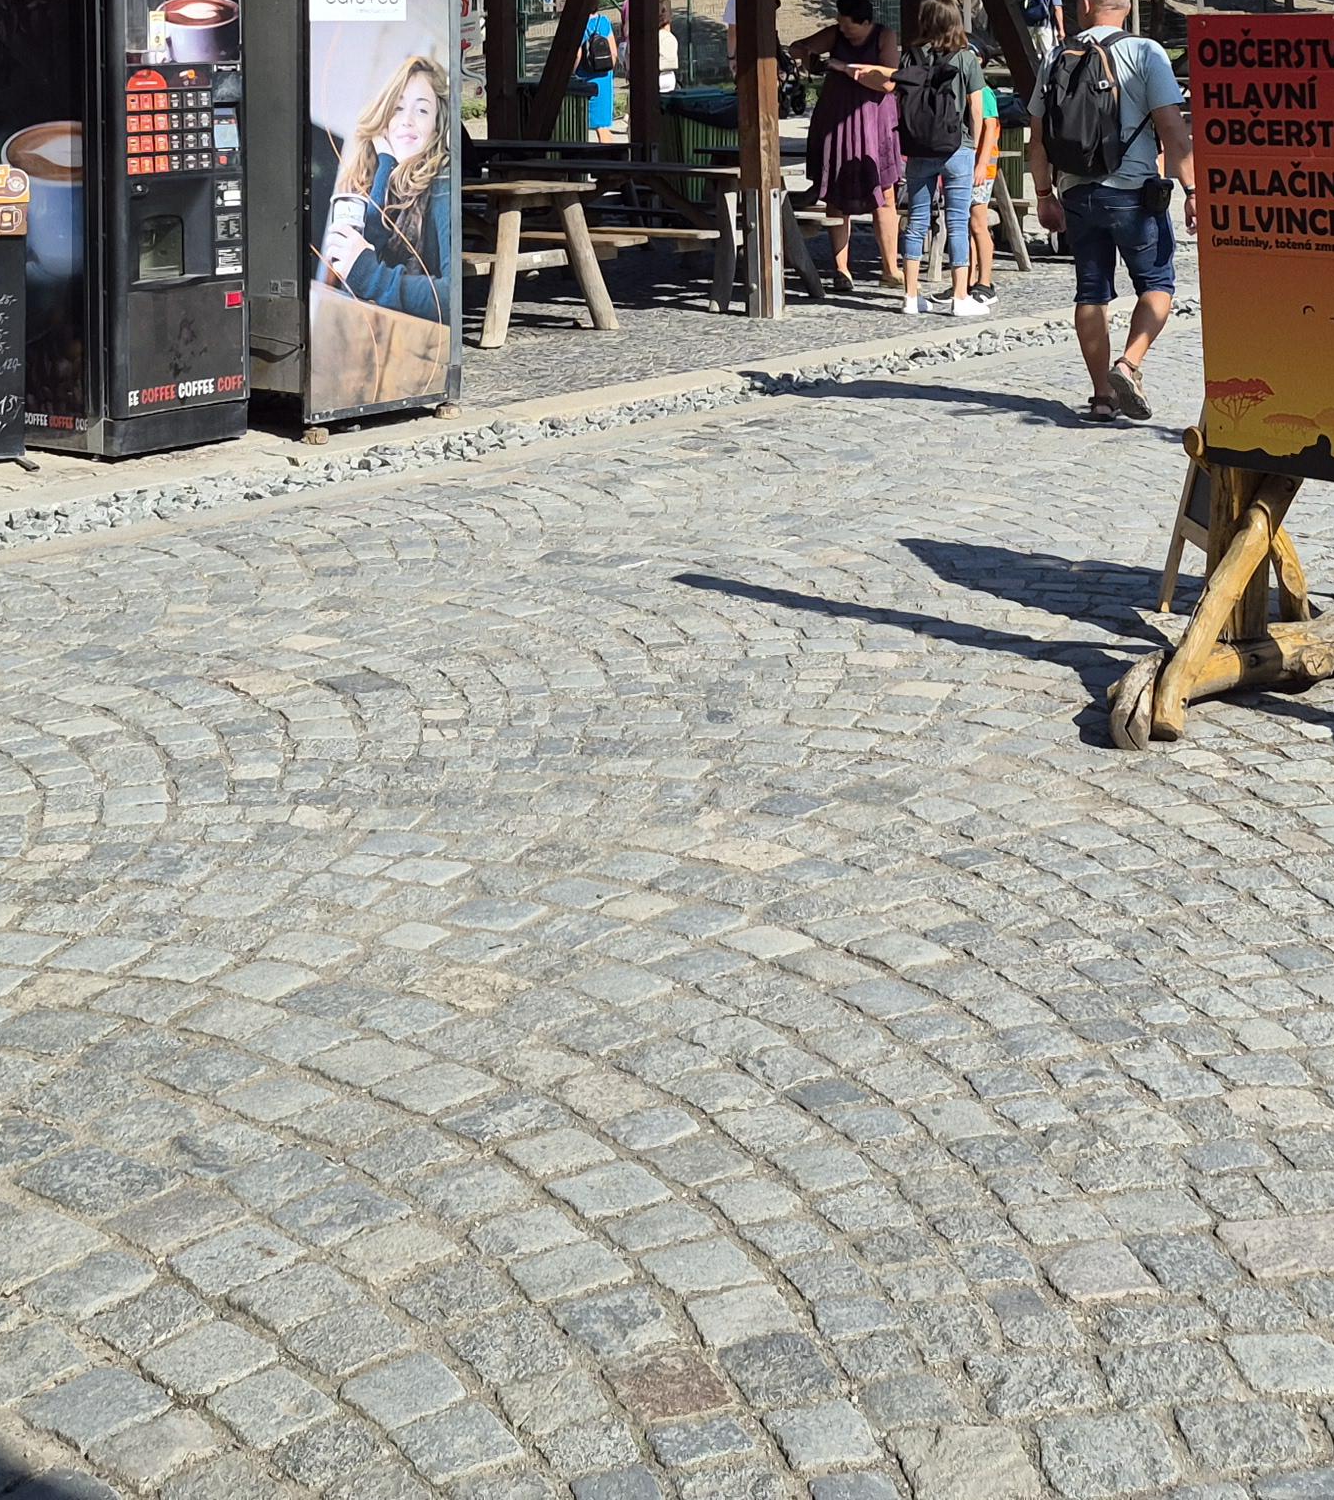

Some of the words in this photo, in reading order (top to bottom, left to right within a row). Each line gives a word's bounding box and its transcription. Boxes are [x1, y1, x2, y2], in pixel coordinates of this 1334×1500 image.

[1203, 75, 1318, 110] HLAVNÍ
[1210, 205, 1231, 232] U
[1211, 235, 1271, 250] (palačinky,
[1275, 237, 1313, 253] točená
[128, 389, 140, 408] EE
[141, 383, 177, 405] COFFEE
[178, 377, 215, 400] COFFEE
[217, 373, 244, 393] COFF
